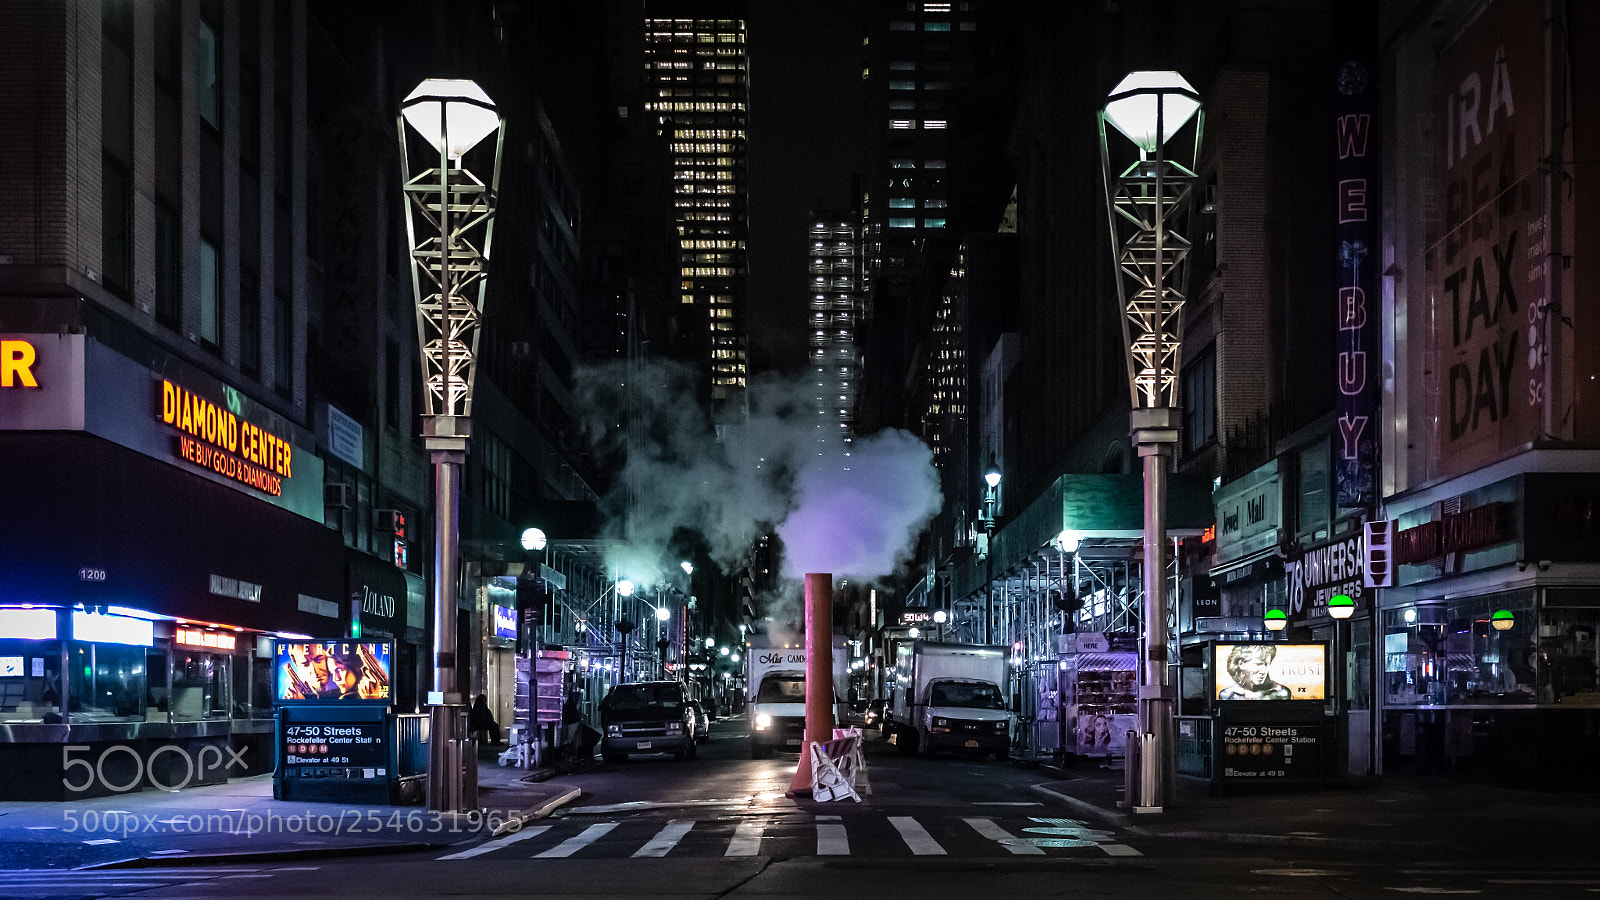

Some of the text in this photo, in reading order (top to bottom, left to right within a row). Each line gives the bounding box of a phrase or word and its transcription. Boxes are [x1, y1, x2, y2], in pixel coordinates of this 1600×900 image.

[1447, 43, 1515, 170] IRA
[1337, 114, 1370, 225] WE
[1444, 229, 1519, 348] TAX
[1338, 286, 1368, 460] BUY
[1449, 329, 1519, 442] DAY
[163, 379, 237, 453] DIAMOND
[241, 421, 292, 479] CENTER
[181, 435, 282, 497] WE BUY GOLD & DIAMONDS
[1222, 505, 1239, 537] Jewel
[1246, 493, 1265, 527] Mall
[80, 569, 106, 580] 1200
[1284, 559, 1304, 616] 78
[1304, 535, 1364, 589] UNIVERSA
[363, 584, 395, 619] ZOLAND
[759, 652, 783, 664] Mia
[1083, 642, 1098, 650] HERE
[1280, 663, 1322, 676] TRUST
[286, 726, 362, 736] 47-50 Streets
[1224, 727, 1298, 736] 47-50 Streets
